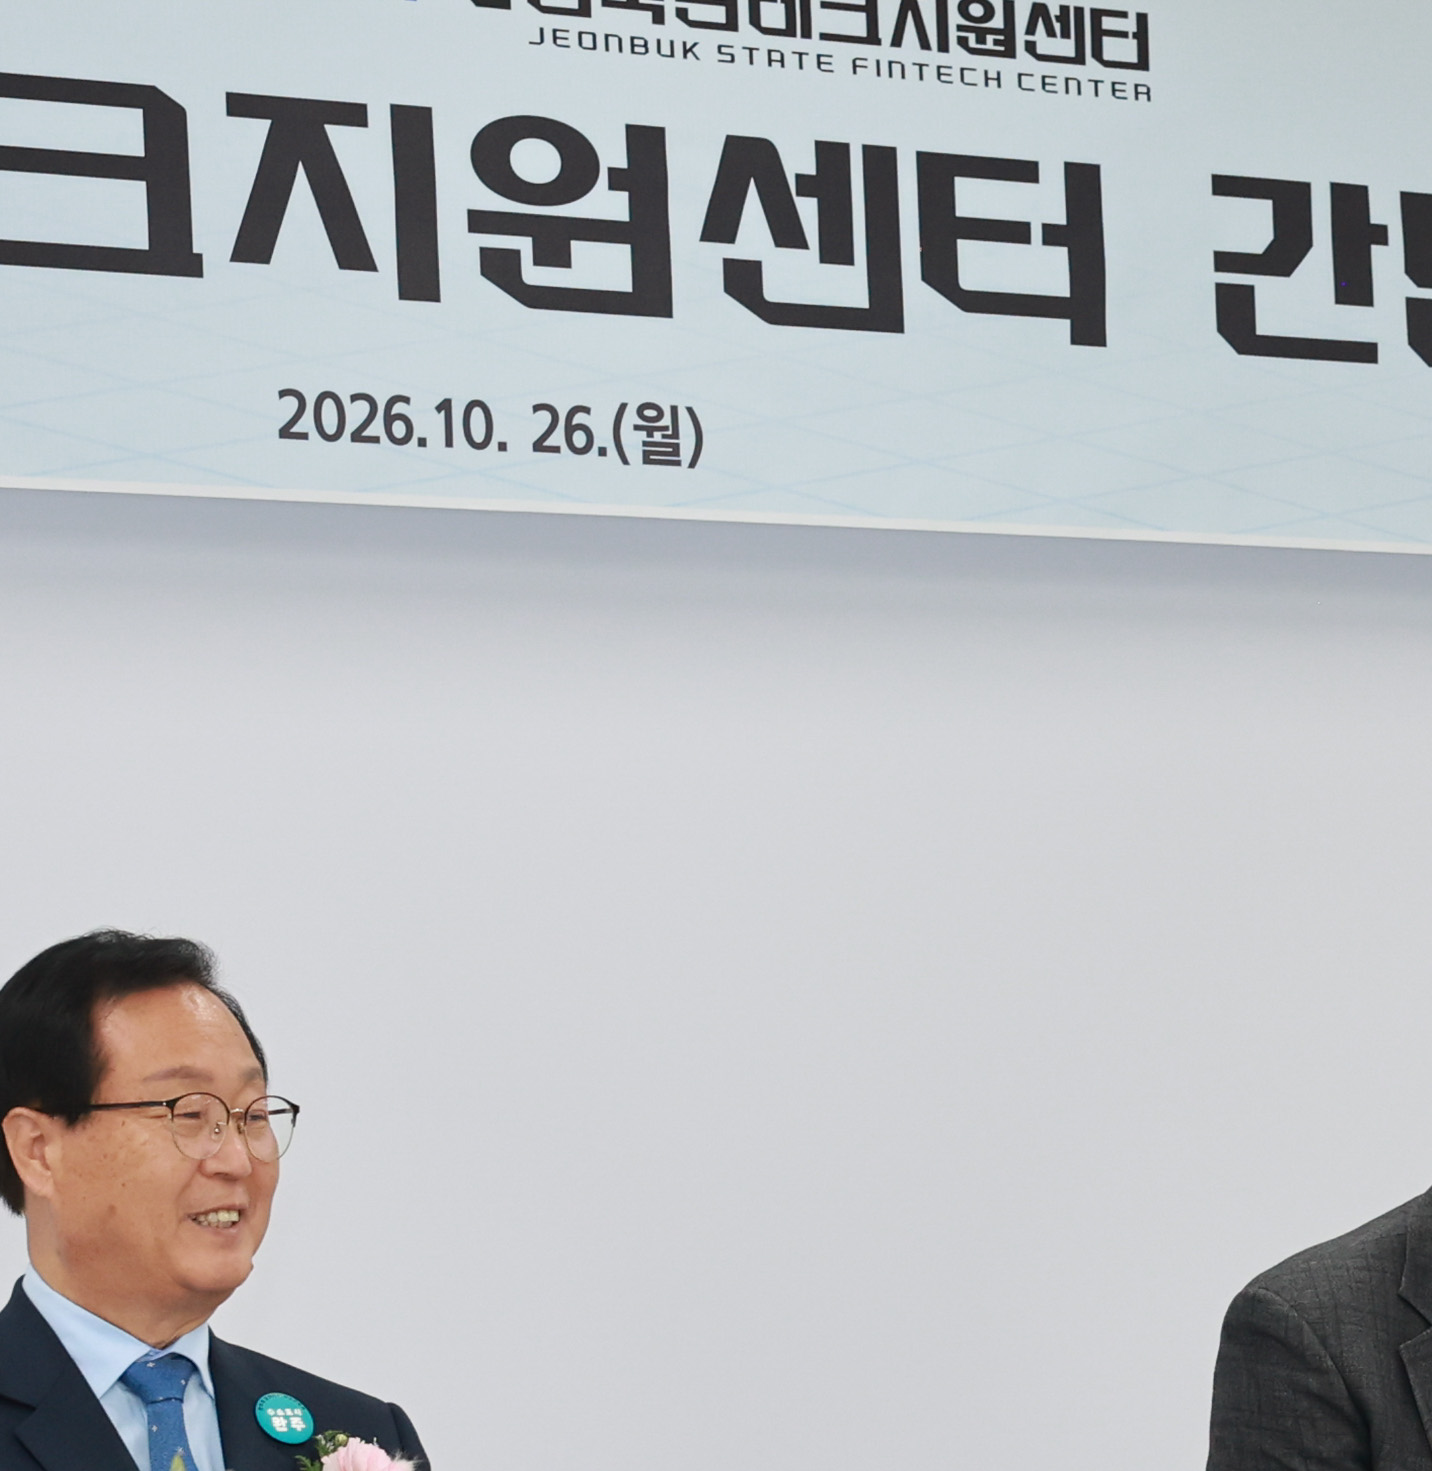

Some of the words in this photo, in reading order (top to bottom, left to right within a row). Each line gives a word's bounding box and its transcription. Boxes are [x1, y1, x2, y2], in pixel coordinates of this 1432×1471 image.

[526, 0, 1150, 72] 테크지원센터
[528, 26, 701, 62] JEONBUK
[716, 43, 835, 73] STATE
[851, 57, 1002, 89] FINTECH
[1016, 72, 1152, 102] CENTER
[277, 387, 508, 452] 2026.10.
[531, 401, 704, 469] 26.(월)
